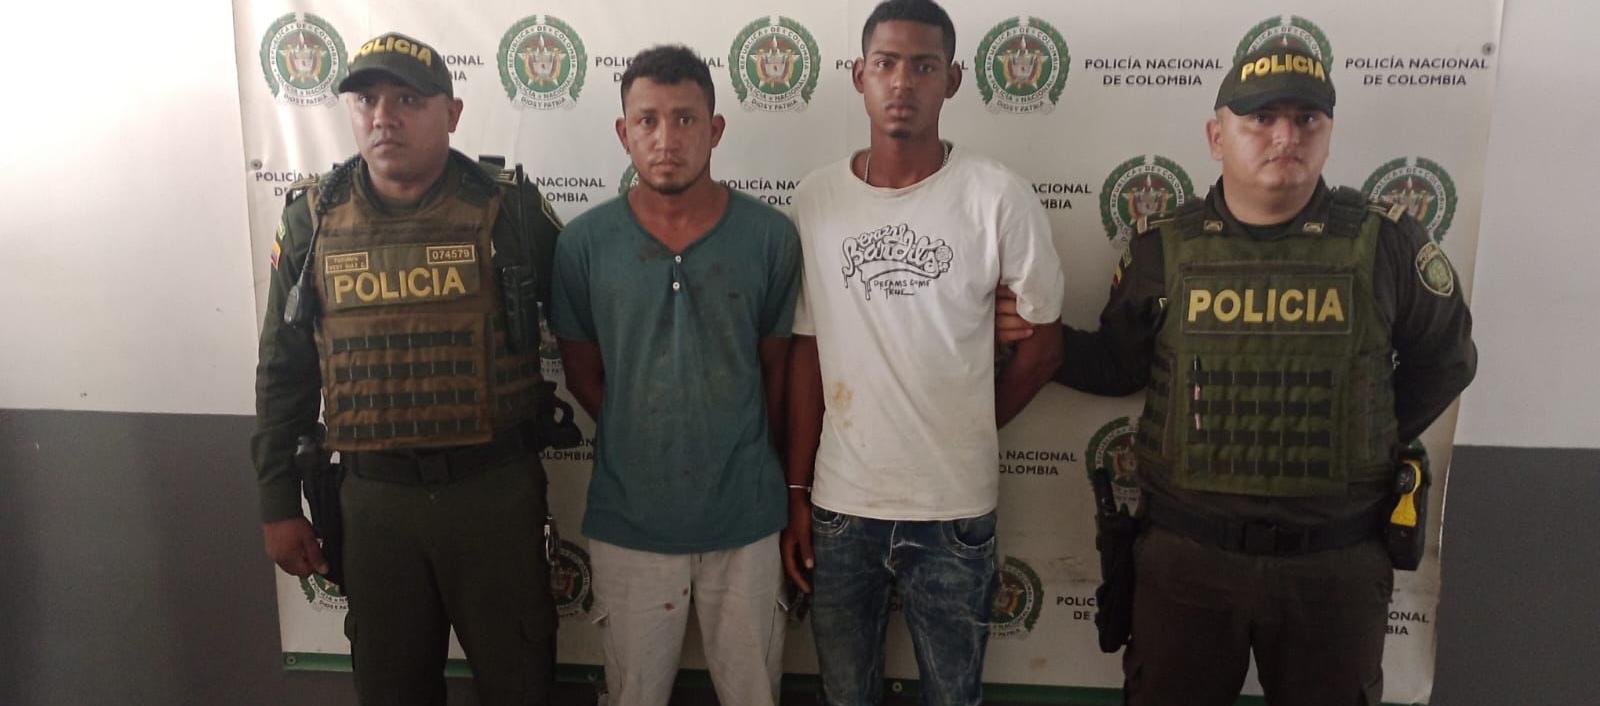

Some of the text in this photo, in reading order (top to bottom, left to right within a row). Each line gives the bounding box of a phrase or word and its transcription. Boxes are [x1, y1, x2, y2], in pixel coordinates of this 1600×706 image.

[1085, 55, 1223, 70] POLICÍA NACIONAL
[1241, 53, 1326, 82] POLICIA
[1345, 55, 1489, 70] POLICÍA NACIONAL
[1103, 74, 1202, 86] DE COLOMBIA
[1364, 74, 1467, 86] DE COLOMBIA
[536, 177, 606, 188] NACIONAL
[1032, 183, 1092, 193] CIONAL
[546, 192, 588, 202] OMBIA
[1040, 199, 1072, 209] MBIA
[432, 249, 470, 260] 074579
[334, 267, 466, 304] POLICIA
[873, 279, 908, 289] DREAMS
[1187, 288, 1344, 322] POLICIA
[1006, 450, 1077, 462] NACIONAL
[999, 464, 1058, 476] OLOMBIA
[1056, 596, 1096, 607] POLIC
[1389, 611, 1430, 623] ONAL
